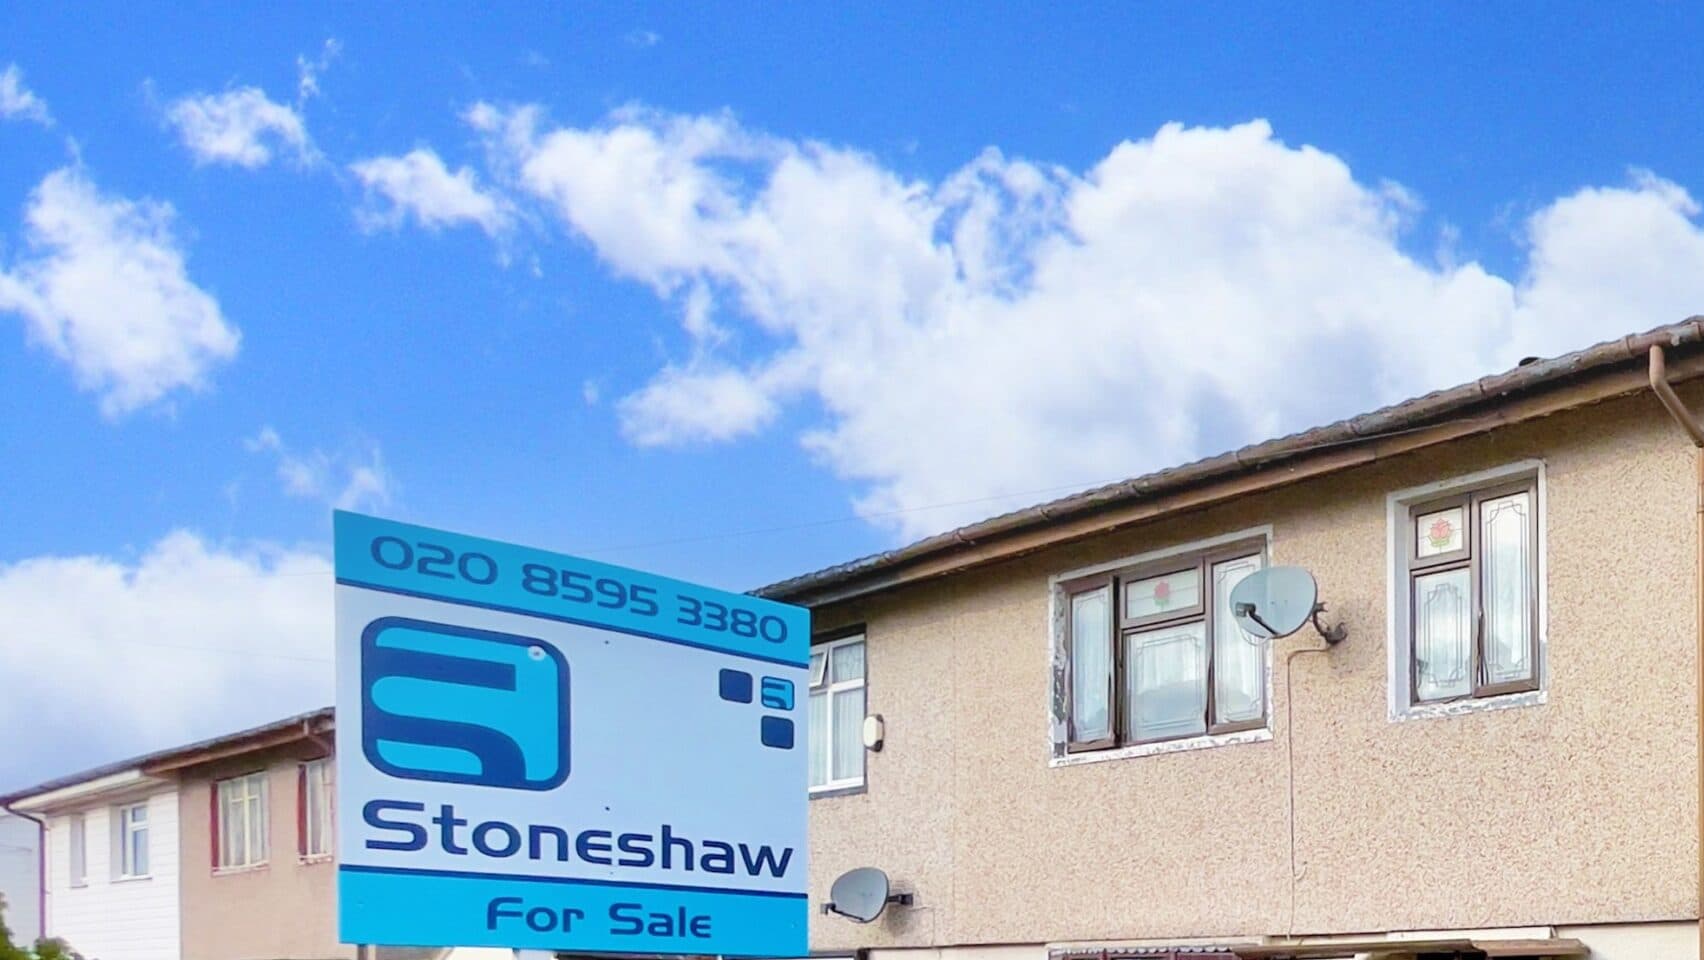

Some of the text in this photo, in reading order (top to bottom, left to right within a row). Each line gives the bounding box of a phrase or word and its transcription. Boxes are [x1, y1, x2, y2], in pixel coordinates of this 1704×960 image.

[370, 535, 788, 644] 020 8595 3380
[361, 799, 794, 878] Stoneshaw
[486, 896, 712, 939] For Sale
